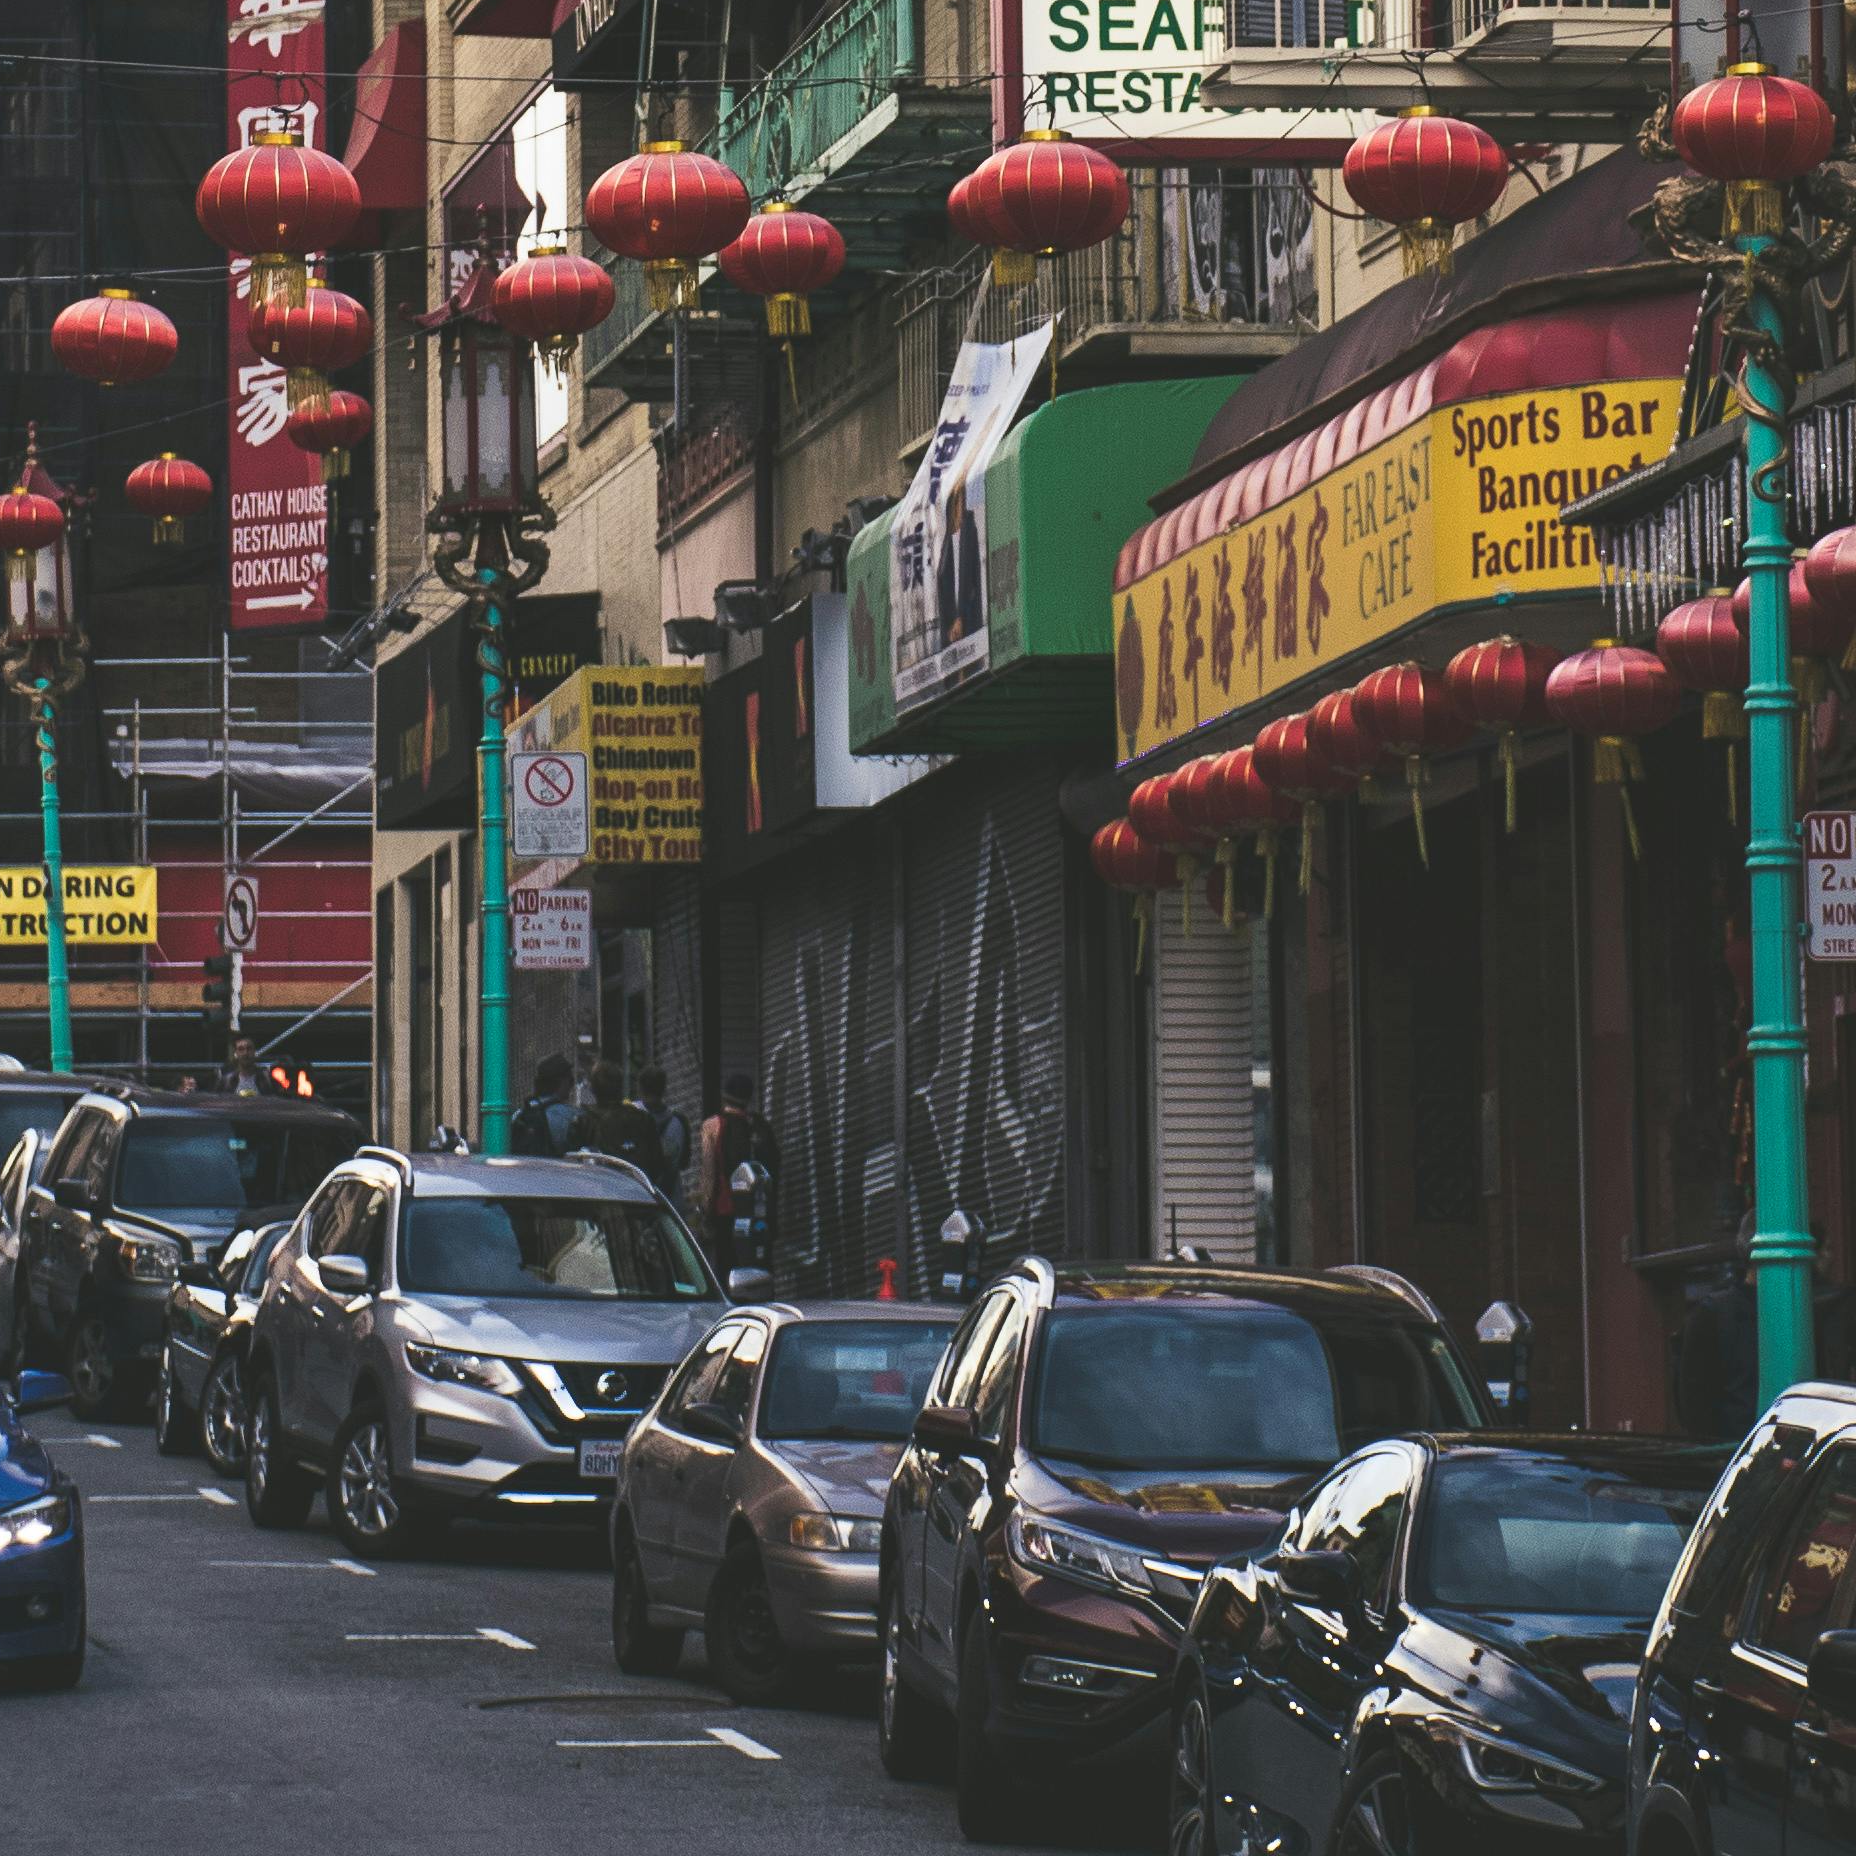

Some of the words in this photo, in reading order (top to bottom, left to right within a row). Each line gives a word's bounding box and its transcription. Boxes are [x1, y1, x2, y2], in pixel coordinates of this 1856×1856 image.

[1452, 400, 1560, 467] Sports
[1581, 391, 1660, 440] Bar
[231, 491, 282, 521] CATHAY
[287, 484, 328, 515] HOUSE
[1342, 470, 1379, 547] FAR
[1383, 435, 1433, 527] EAST
[232, 520, 327, 554] RESTAURANT
[231, 555, 311, 588] COCKTAILS
[592, 681, 638, 706] Bike
[592, 712, 676, 737] Alcatraz
[592, 745, 696, 770] Chinatown
[594, 775, 673, 803] Hop-on
[595, 805, 640, 832] Bay
[594, 834, 646, 862] City
[1810, 817, 1848, 855] NO
[22, 875, 136, 899] DRING
[516, 892, 537, 911] NO
[540, 896, 588, 912] PARKING
[521, 936, 541, 950] MON
[566, 936, 581, 949] FRI
